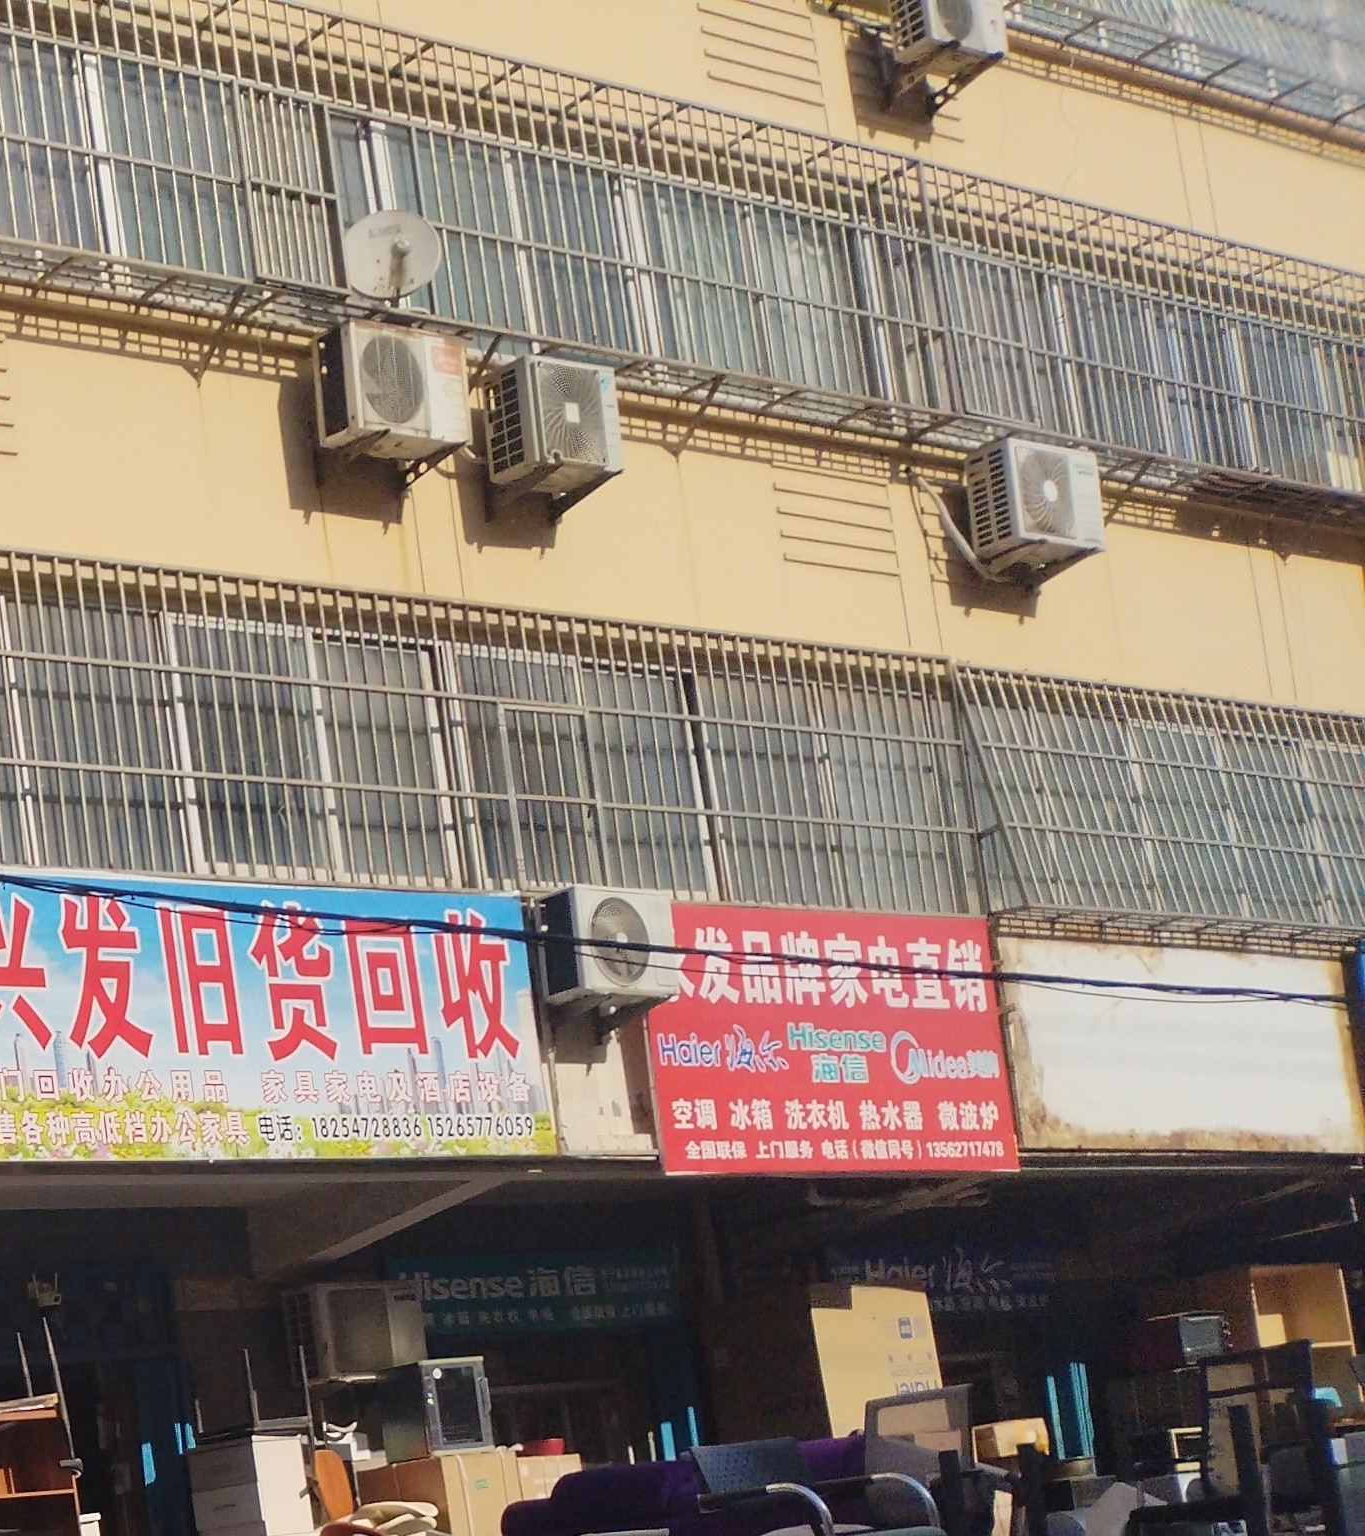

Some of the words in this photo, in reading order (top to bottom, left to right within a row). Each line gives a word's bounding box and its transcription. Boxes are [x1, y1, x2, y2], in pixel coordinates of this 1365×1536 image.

[658, 1032, 722, 1068] Haier
[786, 1022, 888, 1053] Hisense
[811, 1053, 870, 1084] 海信
[260, 1069, 532, 1104] 家具家电及酒店设备
[311, 1116, 423, 1139] 18254728836
[426, 1114, 535, 1137] 15265776059
[671, 1097, 718, 1131] 空调
[728, 1097, 774, 1131] 冰箱
[784, 1098, 850, 1132] 洗衣机
[858, 1099, 925, 1132] 热水器
[936, 1099, 1001, 1132] 微波炉
[754, 1139, 815, 1160] 上门服务
